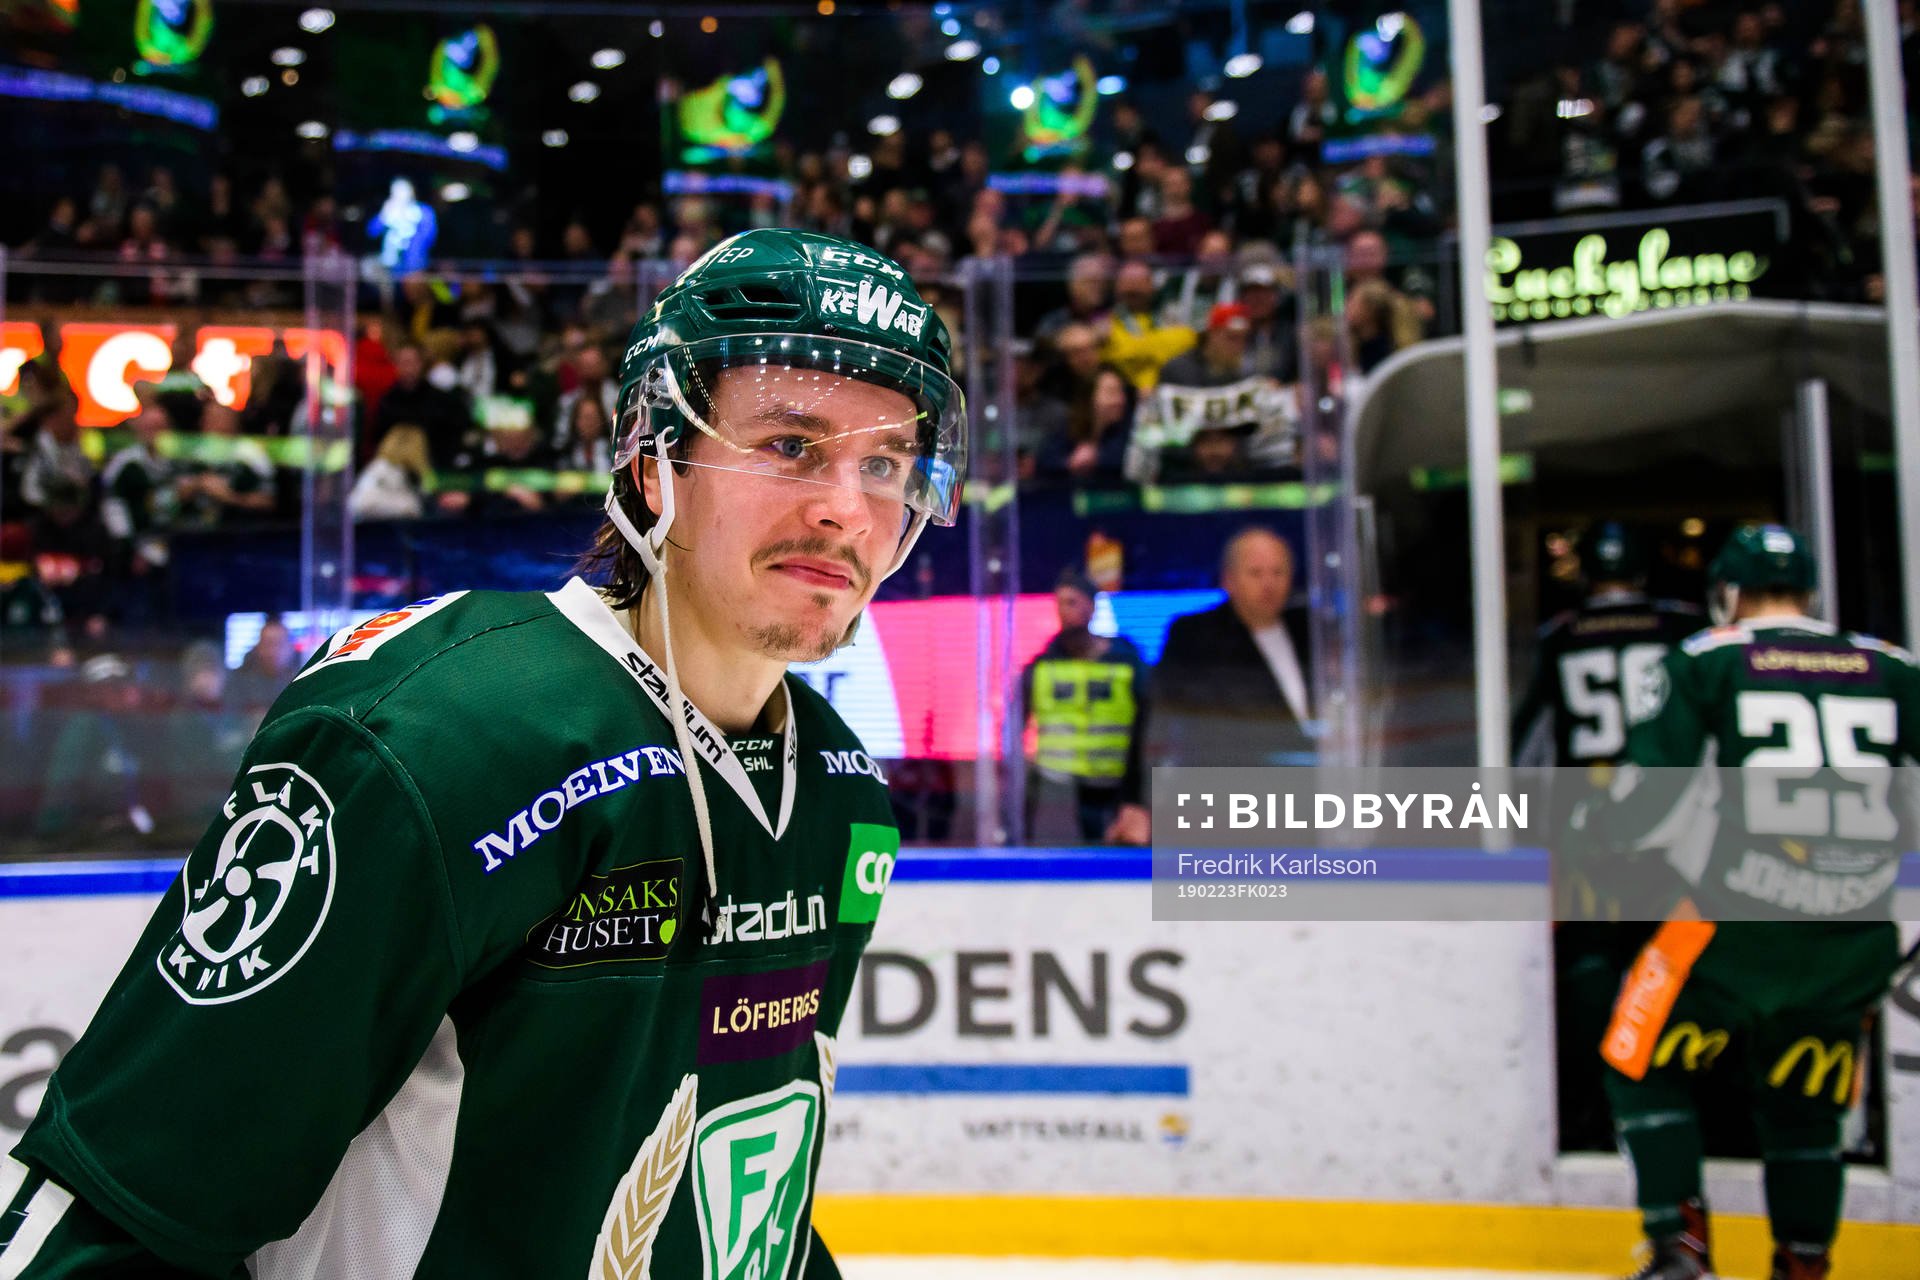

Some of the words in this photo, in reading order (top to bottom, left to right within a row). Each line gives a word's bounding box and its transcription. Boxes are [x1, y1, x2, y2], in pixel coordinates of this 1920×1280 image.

[822, 247, 904, 280] CCM
[625, 335, 661, 363] CCM
[732, 739, 774, 751] CCM
[744, 756, 774, 772] SHL
[1737, 690, 1899, 841] 25
[474, 746, 687, 872] MOELVEN
[543, 914, 660, 954] HUSET
[713, 989, 819, 1034] LÖFBERGS
[859, 949, 1189, 1038] DENS
